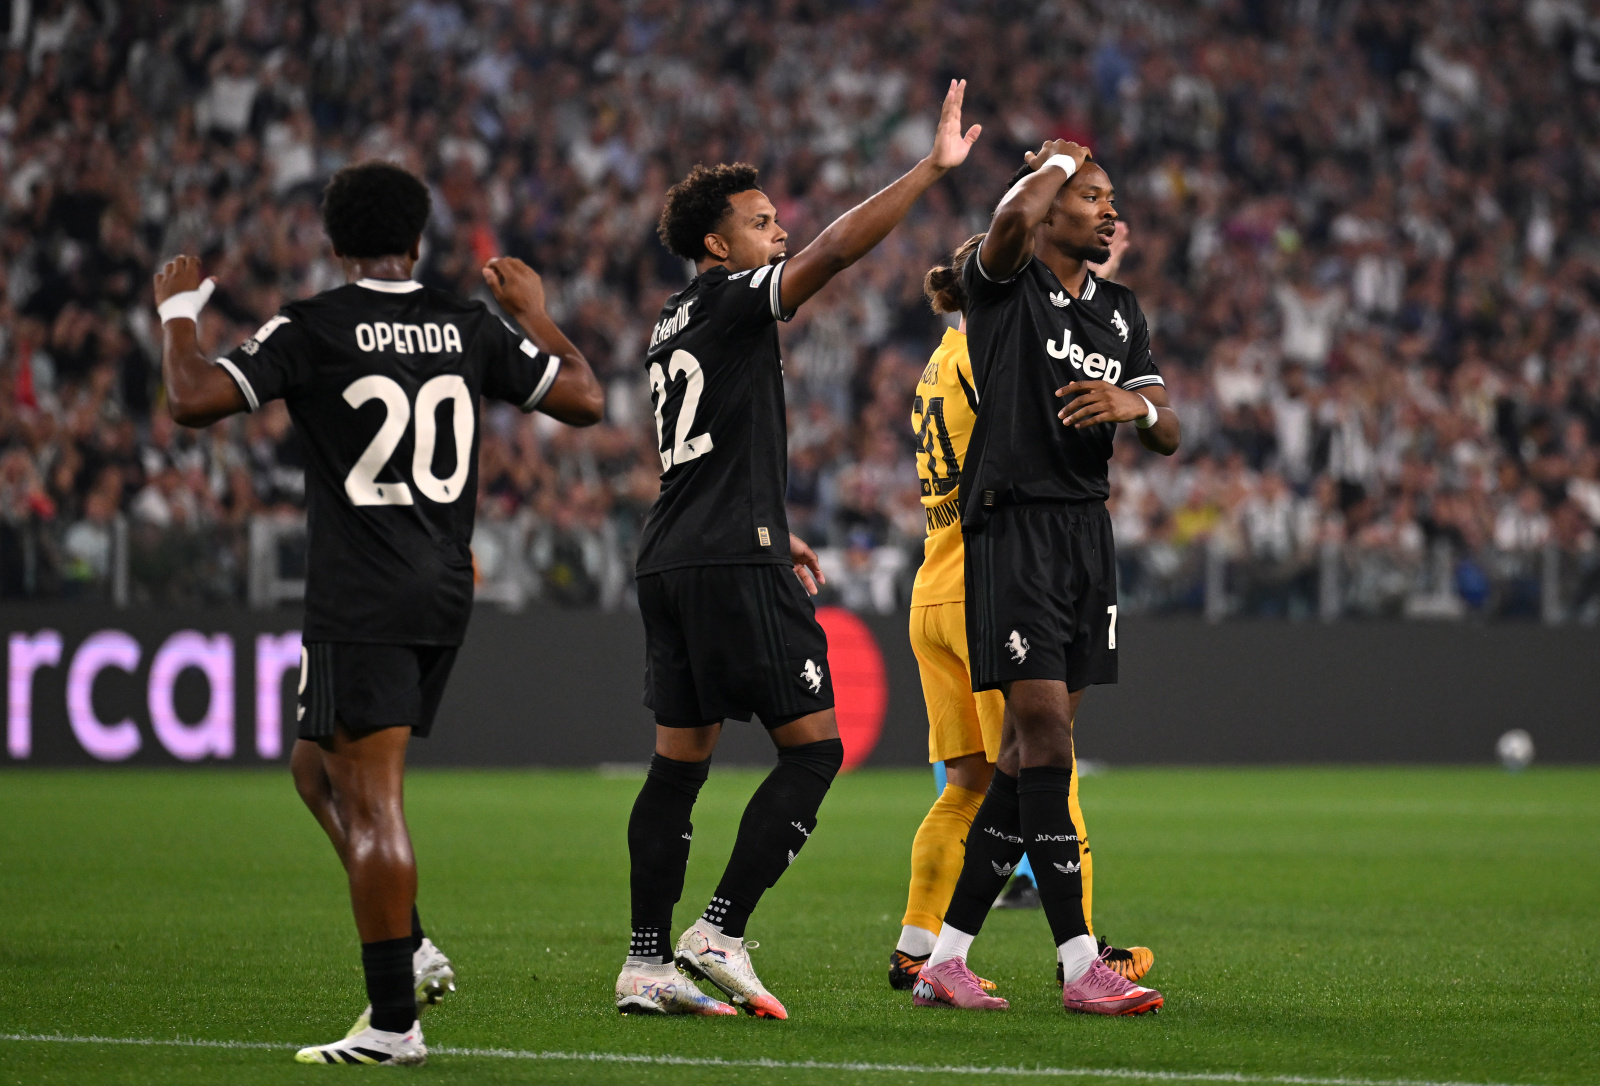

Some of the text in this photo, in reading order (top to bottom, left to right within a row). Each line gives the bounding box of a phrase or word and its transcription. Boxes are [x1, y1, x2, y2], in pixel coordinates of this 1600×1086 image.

[355, 322, 462, 354] OPENDA
[1046, 328, 1121, 385] Jeep
[342, 374, 474, 506] 20
[650, 349, 714, 474] 22
